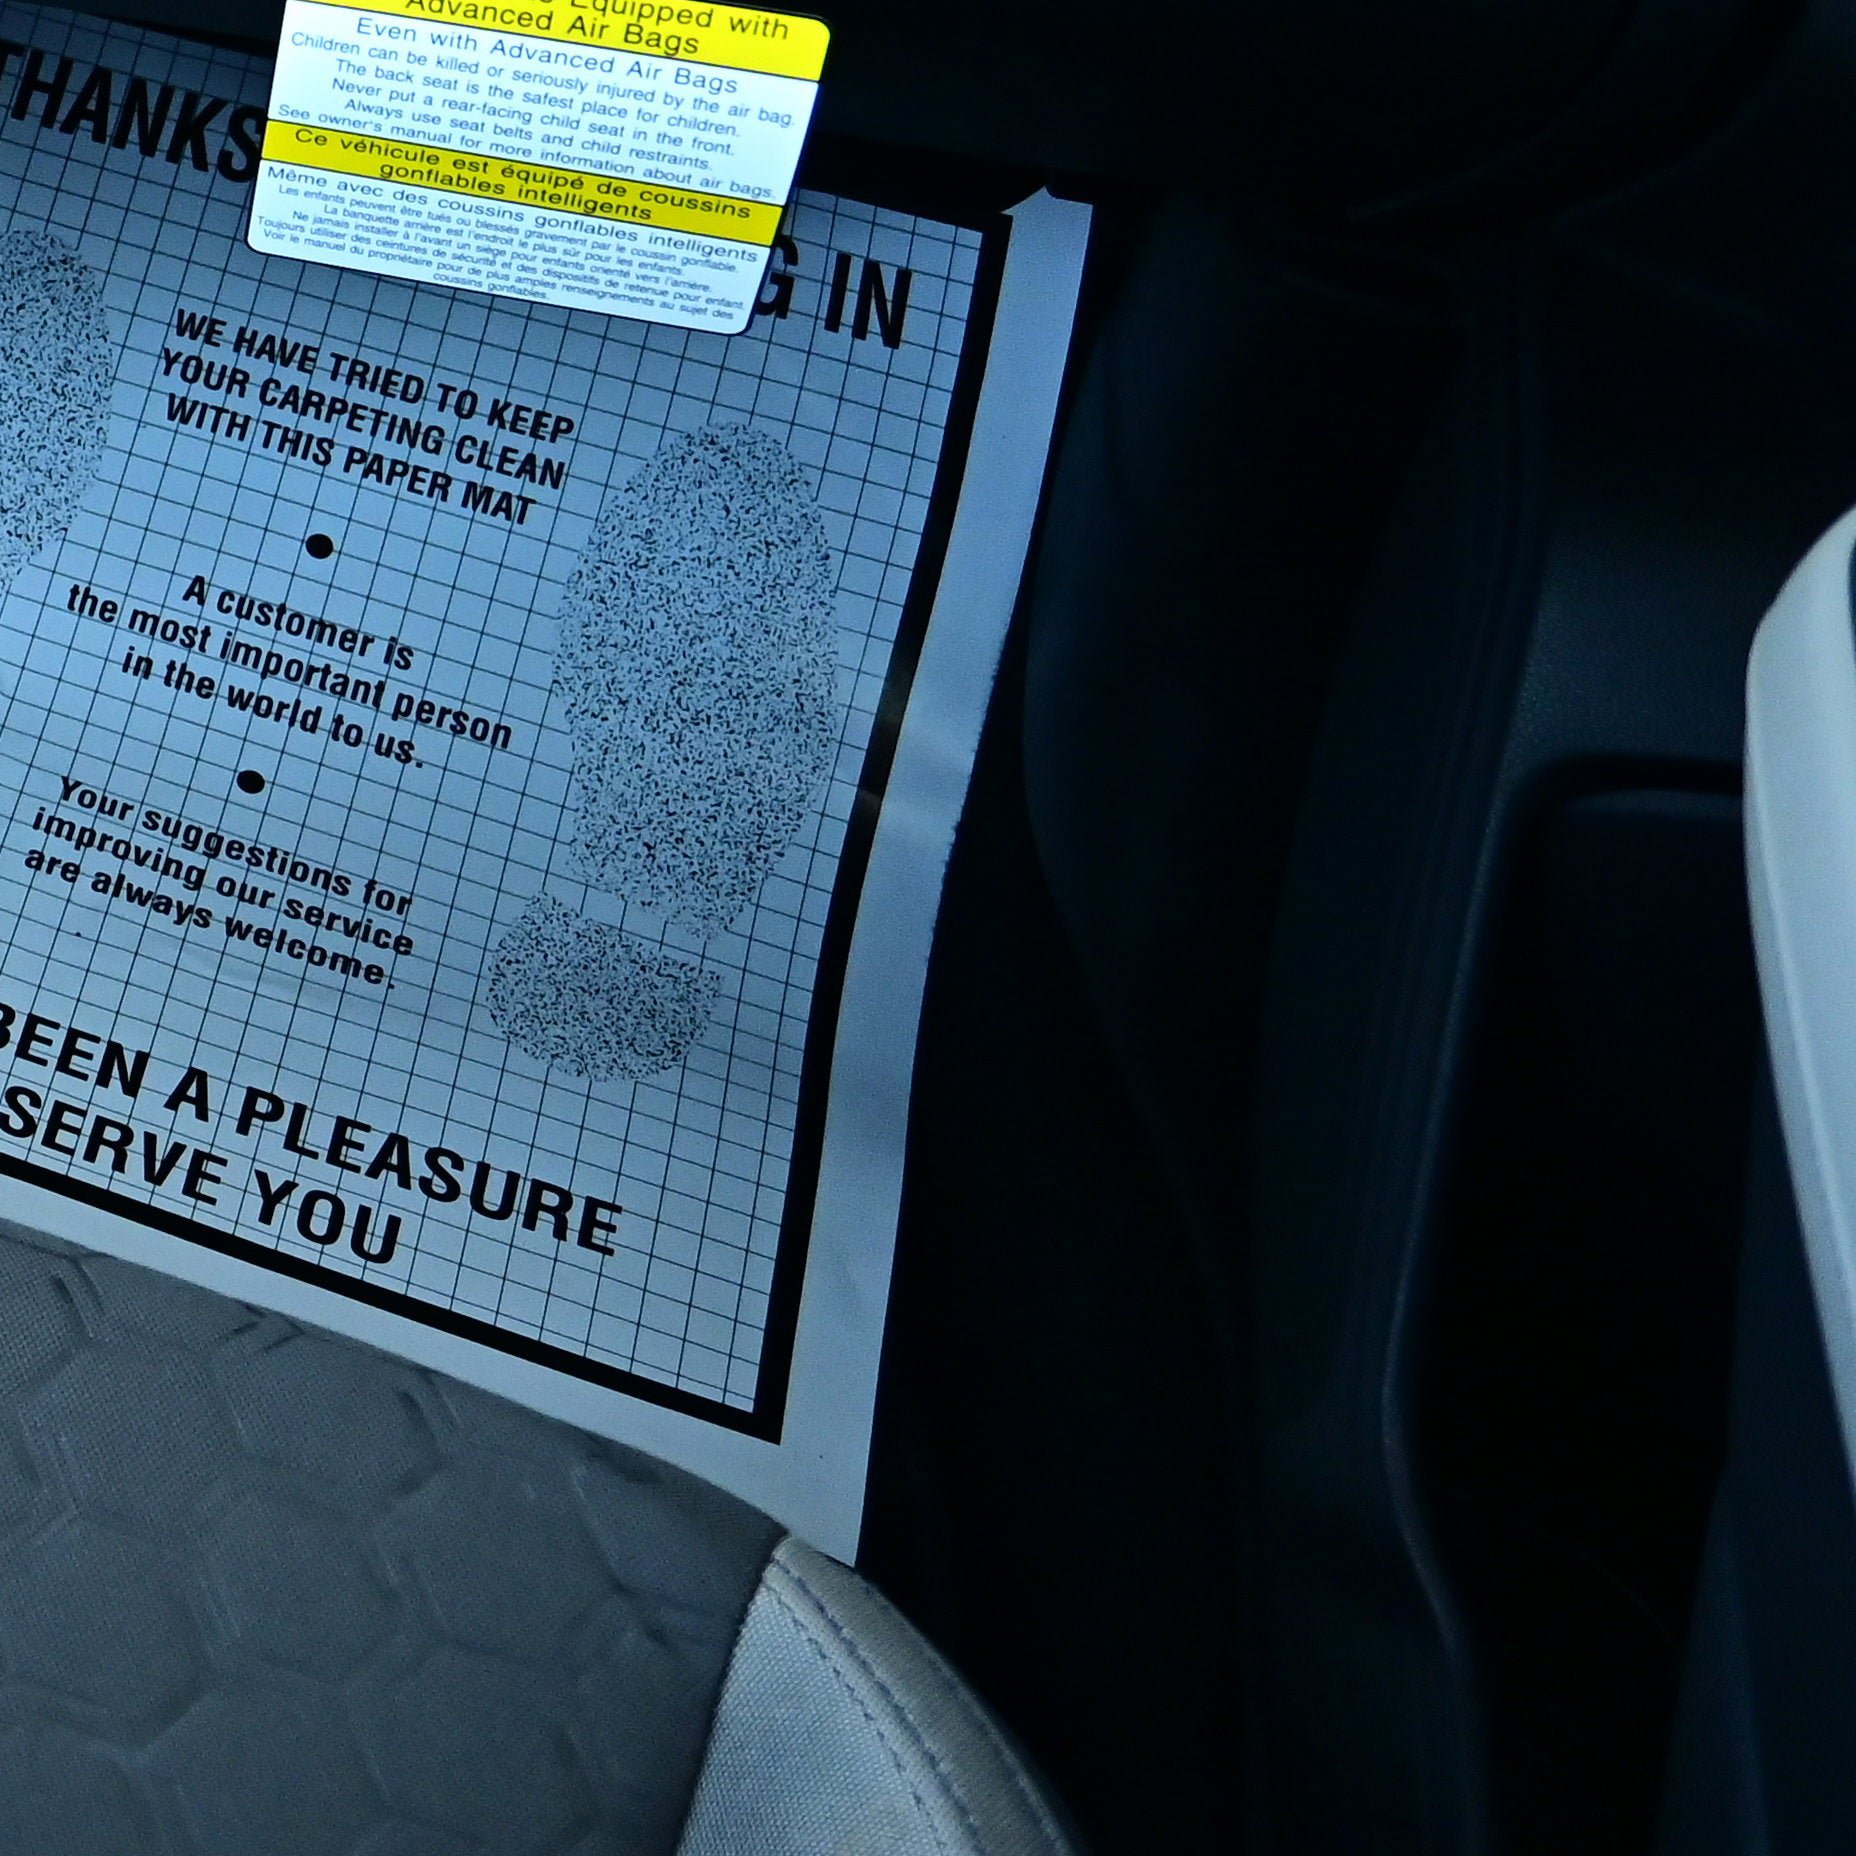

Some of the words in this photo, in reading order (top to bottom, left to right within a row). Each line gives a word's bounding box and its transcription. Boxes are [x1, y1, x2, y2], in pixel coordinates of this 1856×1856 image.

[291, 32, 360, 55] Children
[368, 47, 399, 62] can
[406, 50, 428, 66] be
[436, 55, 480, 76] killed
[487, 65, 505, 78] or
[511, 68, 588, 94] seriously
[596, 81, 655, 104] injured
[662, 89, 684, 111] by
[692, 97, 720, 114] the
[728, 104, 751, 119] air
[356, 16, 417, 42] Even
[430, 29, 478, 52] with
[489, 39, 615, 73] Advanced
[627, 60, 663, 81] Air
[674, 67, 738, 95] Bags
[567, 14, 610, 40] Air
[624, 23, 700, 57] Bags
[729, 15, 789, 40] with
[295, 128, 328, 146] Ce
[340, 135, 440, 165] véhicule
[452, 158, 489, 175] est
[501, 164, 585, 190] équipé
[596, 179, 627, 198] de
[639, 190, 752, 219] coussins
[379, 165, 506, 195] gonflables
[518, 185, 653, 220] intelligents
[824, 251, 913, 350] IN
[161, 347, 251, 399] YOUR
[258, 377, 445, 456] CARPETING
[454, 434, 566, 490] CLEAN
[175, 308, 227, 348] WE
[232, 326, 320, 375] HAVE
[329, 352, 425, 405] TRIED
[436, 382, 478, 420] TO
[486, 399, 575, 445] KEEP
[166, 392, 251, 442] WITH
[260, 419, 336, 467] THIS
[343, 445, 453, 503] PAPER
[461, 481, 537, 525] MAT
[66, 584, 118, 623] the
[127, 607, 212, 654] most
[218, 631, 386, 709] important
[391, 691, 513, 749] person
[182, 574, 206, 606] A
[216, 587, 375, 658] customer
[382, 635, 415, 671] is
[121, 646, 155, 680] in
[163, 659, 217, 700] the
[227, 683, 323, 734] world
[331, 712, 363, 747] to
[373, 733, 424, 769] us.
[32, 806, 208, 891] improving
[216, 875, 276, 909] our
[283, 896, 415, 957] service
[60, 775, 134, 821] Your
[142, 808, 352, 897] suggestions
[363, 879, 413, 916] for
[24, 848, 81, 884] are
[90, 870, 214, 929] always
[224, 915, 396, 990] welcome.
[163, 1065, 211, 1123] A
[234, 1085, 624, 1256] PLEASURE
[254, 1169, 403, 1265] YOU
